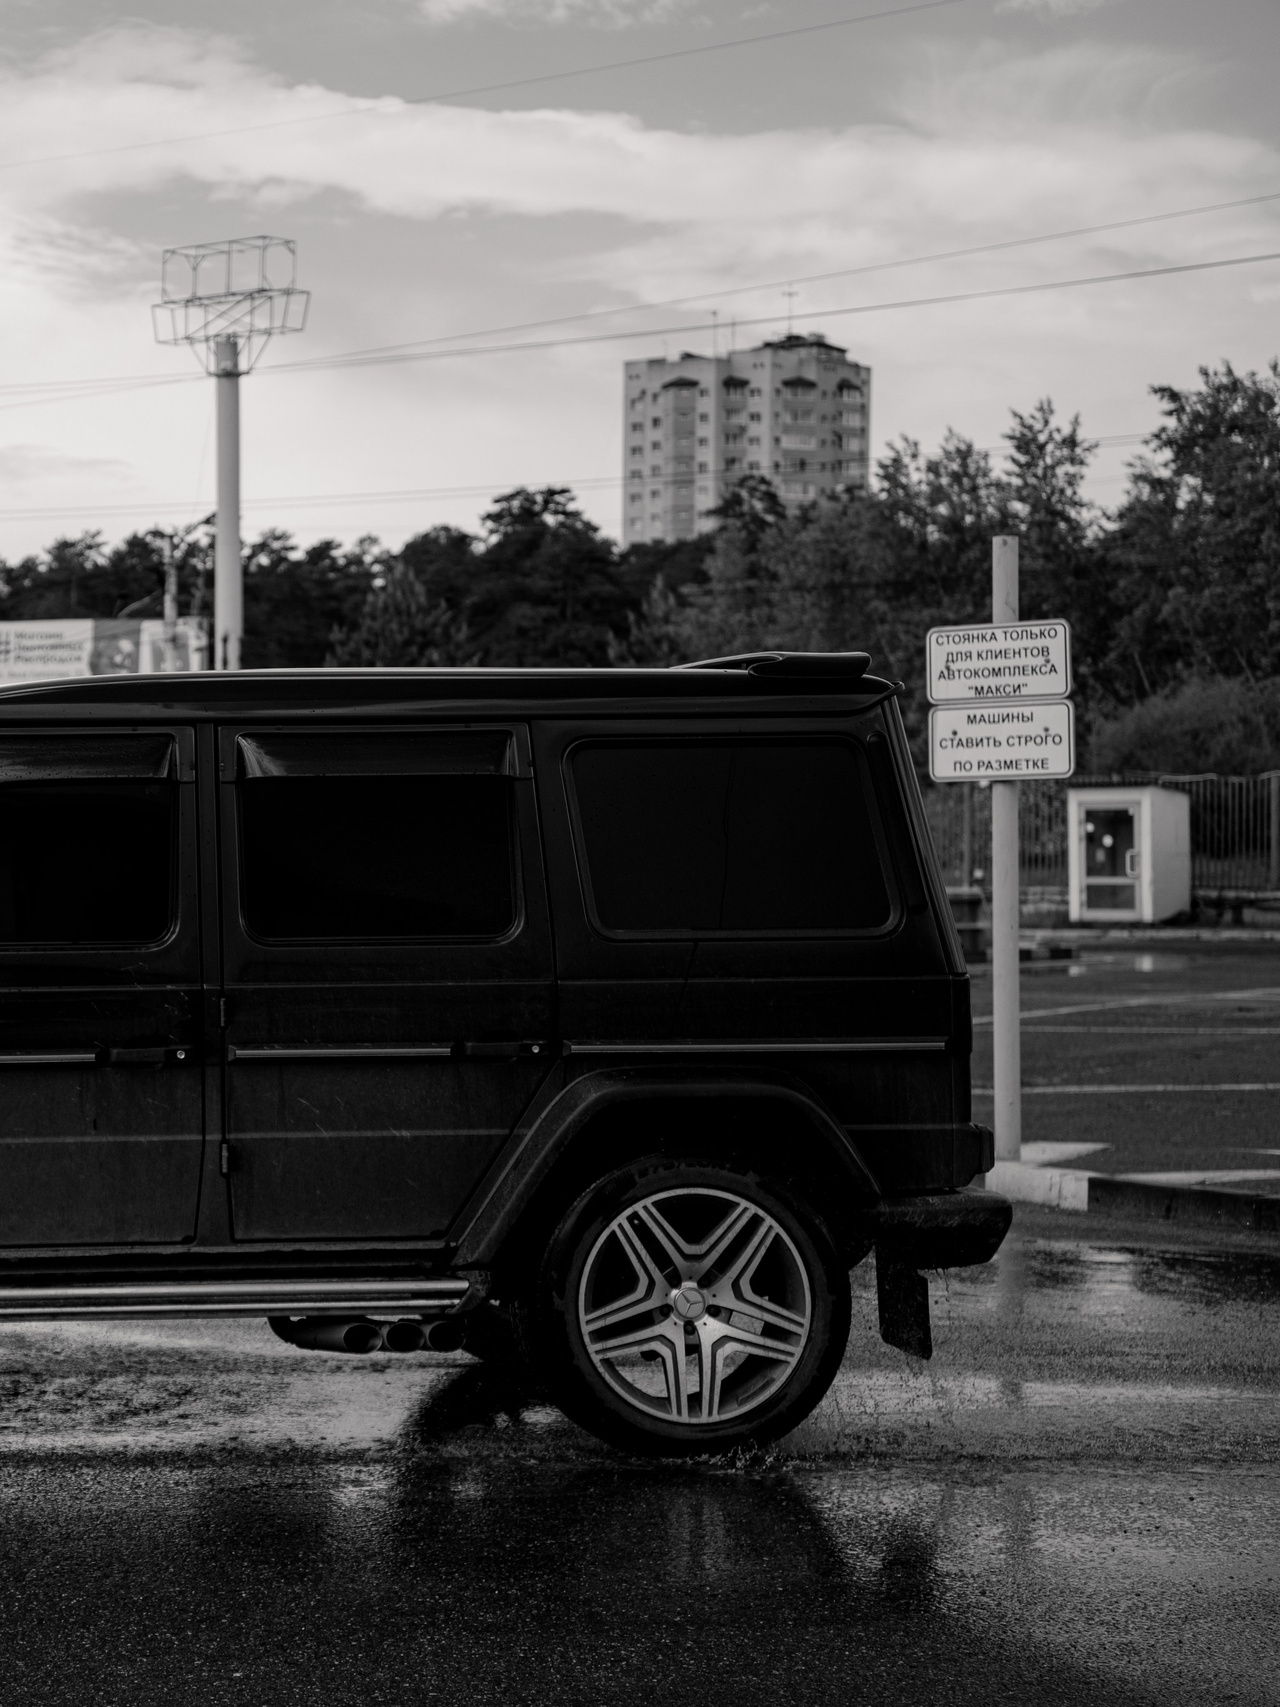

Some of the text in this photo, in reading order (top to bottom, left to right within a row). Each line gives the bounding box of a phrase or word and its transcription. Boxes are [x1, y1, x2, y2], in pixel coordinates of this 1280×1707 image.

[935, 627, 1058, 646] СТОЯНКА ТОЛЬКО
[945, 645, 1051, 664] ДЛЯ КЛИЕНТОВ
[937, 664, 1058, 681] АВТОКОМПЛЕКСА
[968, 683, 1028, 697] "МАКСИ"
[966, 711, 1034, 726] МАШИНЫ
[939, 733, 1063, 750] СТАВИТЬ СТРОГО
[953, 757, 1050, 773] ПО РАЗМЕТКЕ
